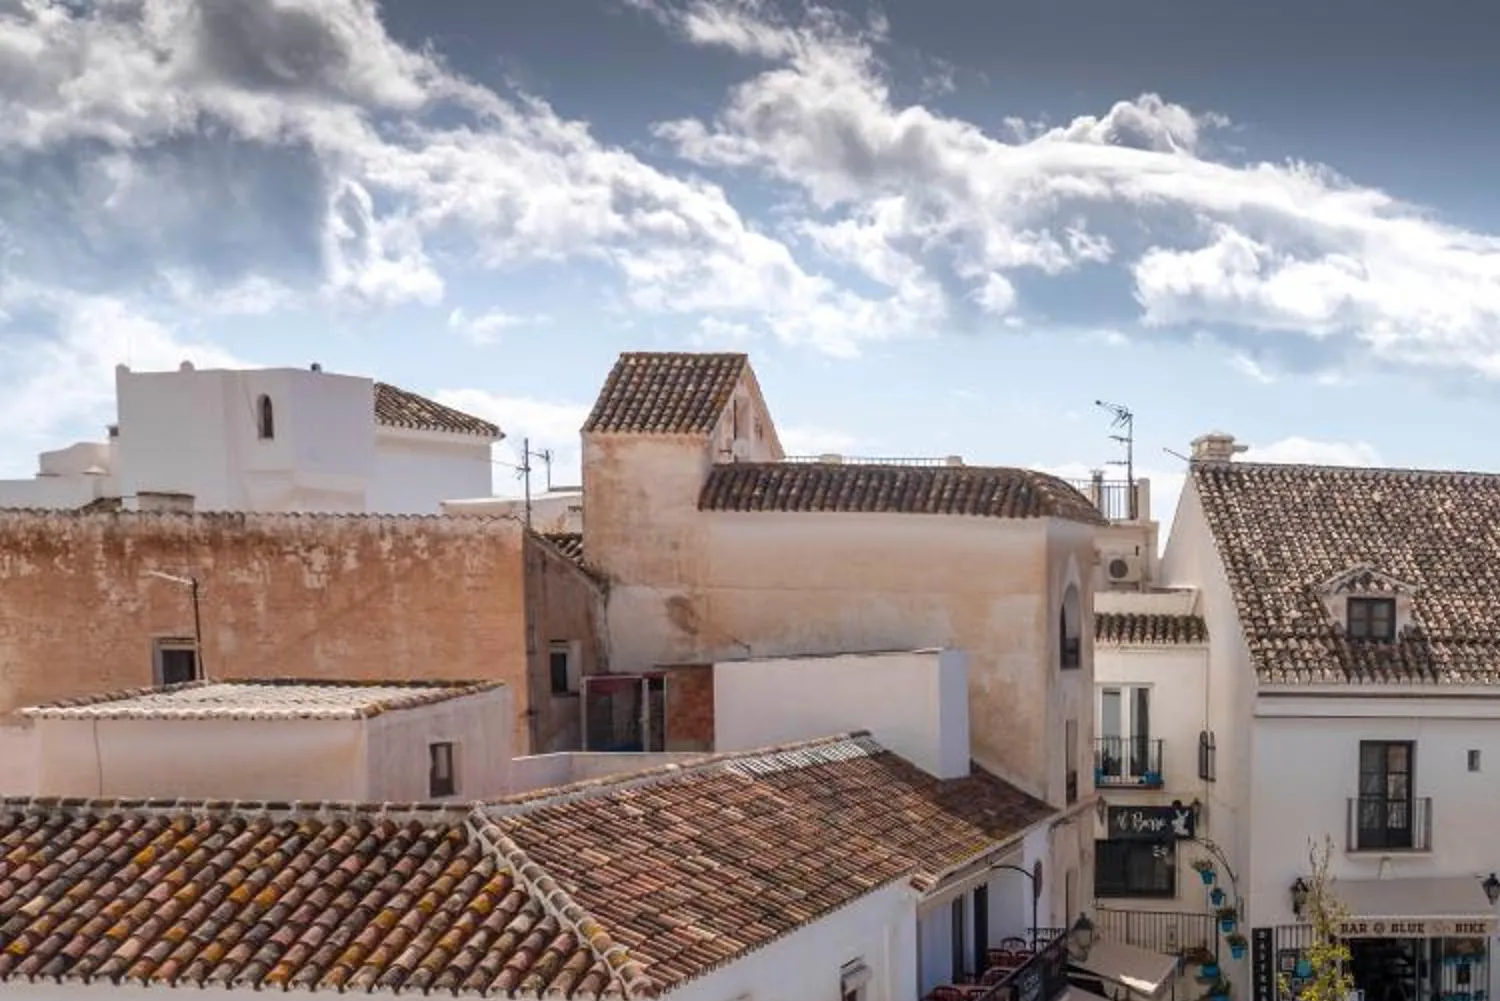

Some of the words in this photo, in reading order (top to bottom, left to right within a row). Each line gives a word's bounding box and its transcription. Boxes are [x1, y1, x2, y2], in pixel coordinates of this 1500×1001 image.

[1340, 922, 1368, 933] BAR
[1391, 922, 1425, 933] BLUE
[1455, 921, 1487, 933] BIKE
